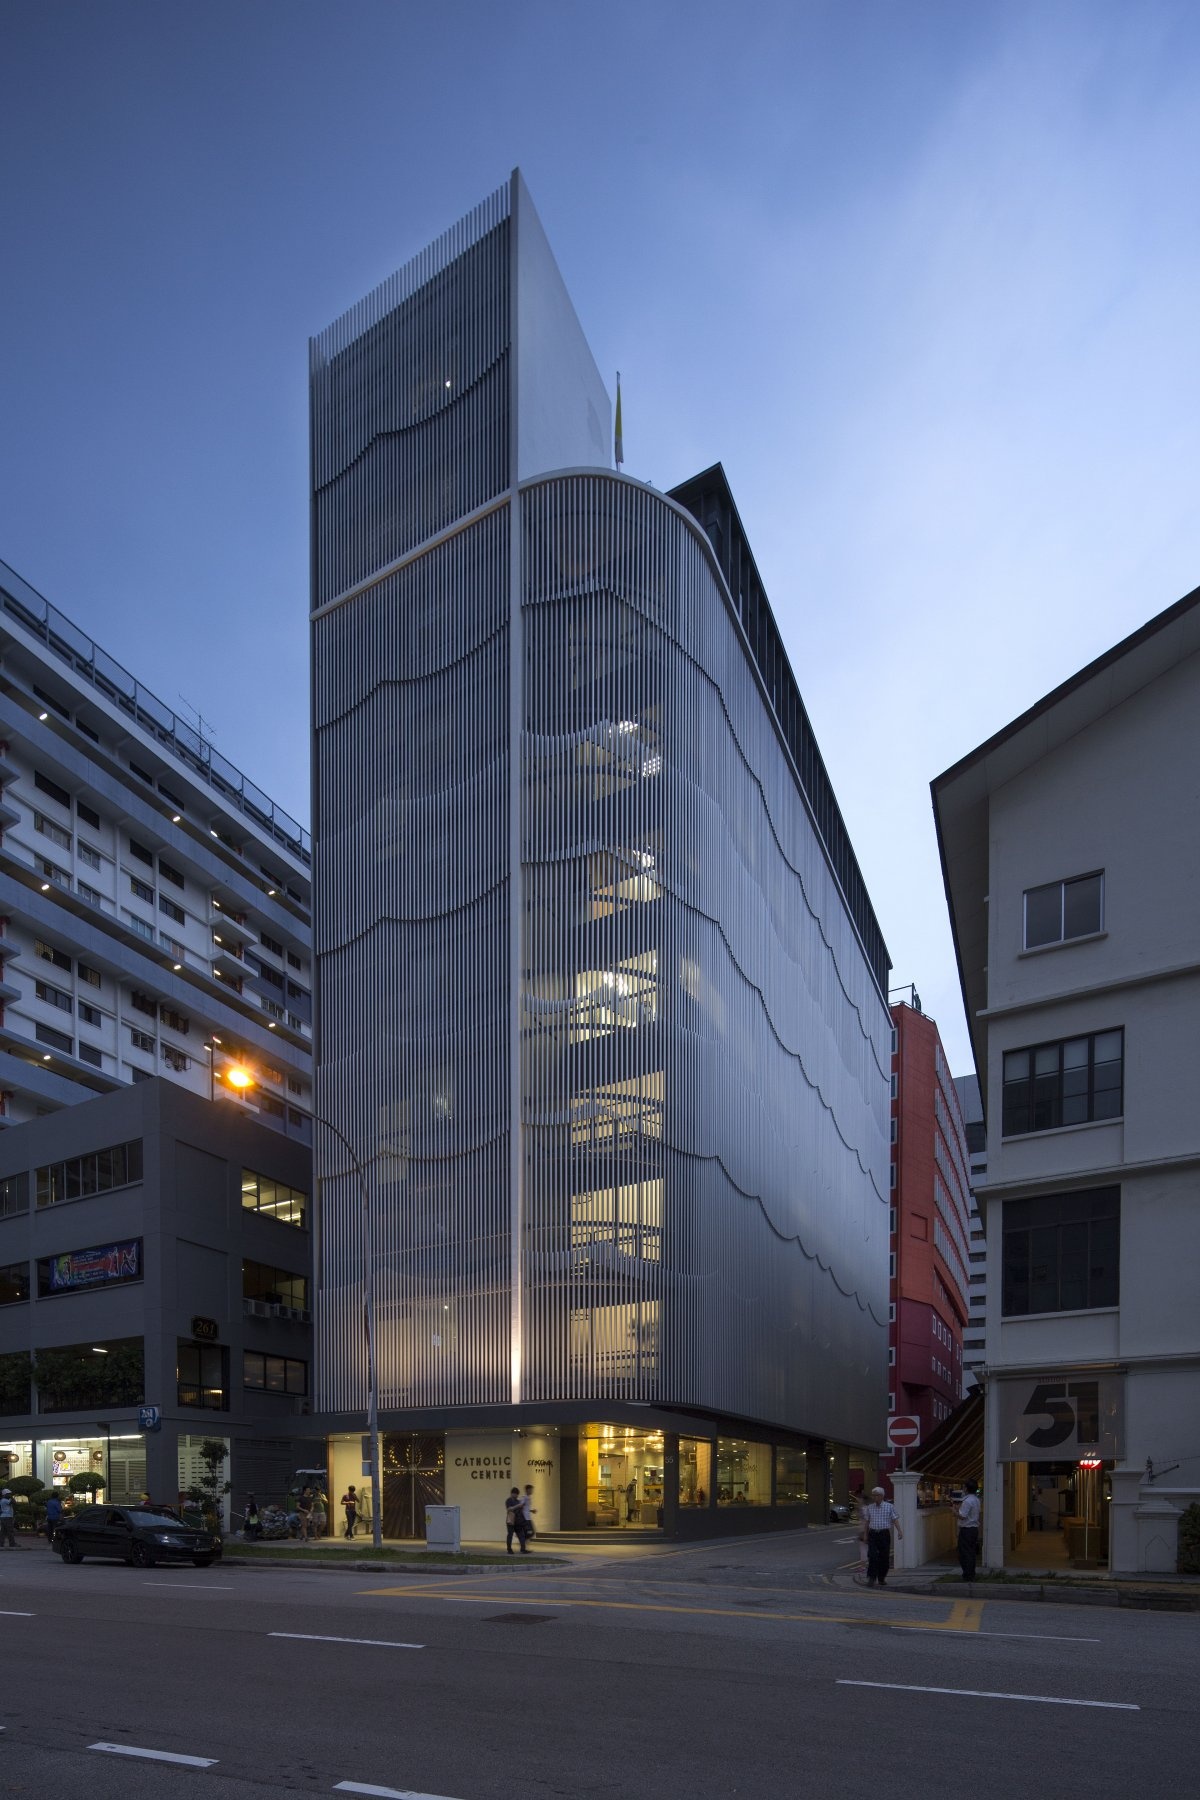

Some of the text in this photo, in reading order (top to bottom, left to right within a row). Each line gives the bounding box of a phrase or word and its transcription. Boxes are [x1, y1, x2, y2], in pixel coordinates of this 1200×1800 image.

[195, 1320, 215, 1335] 261
[1023, 1382, 1100, 1448] 51
[455, 1457, 511, 1467] CATHOLIC
[471, 1469, 512, 1479] CENTRE
